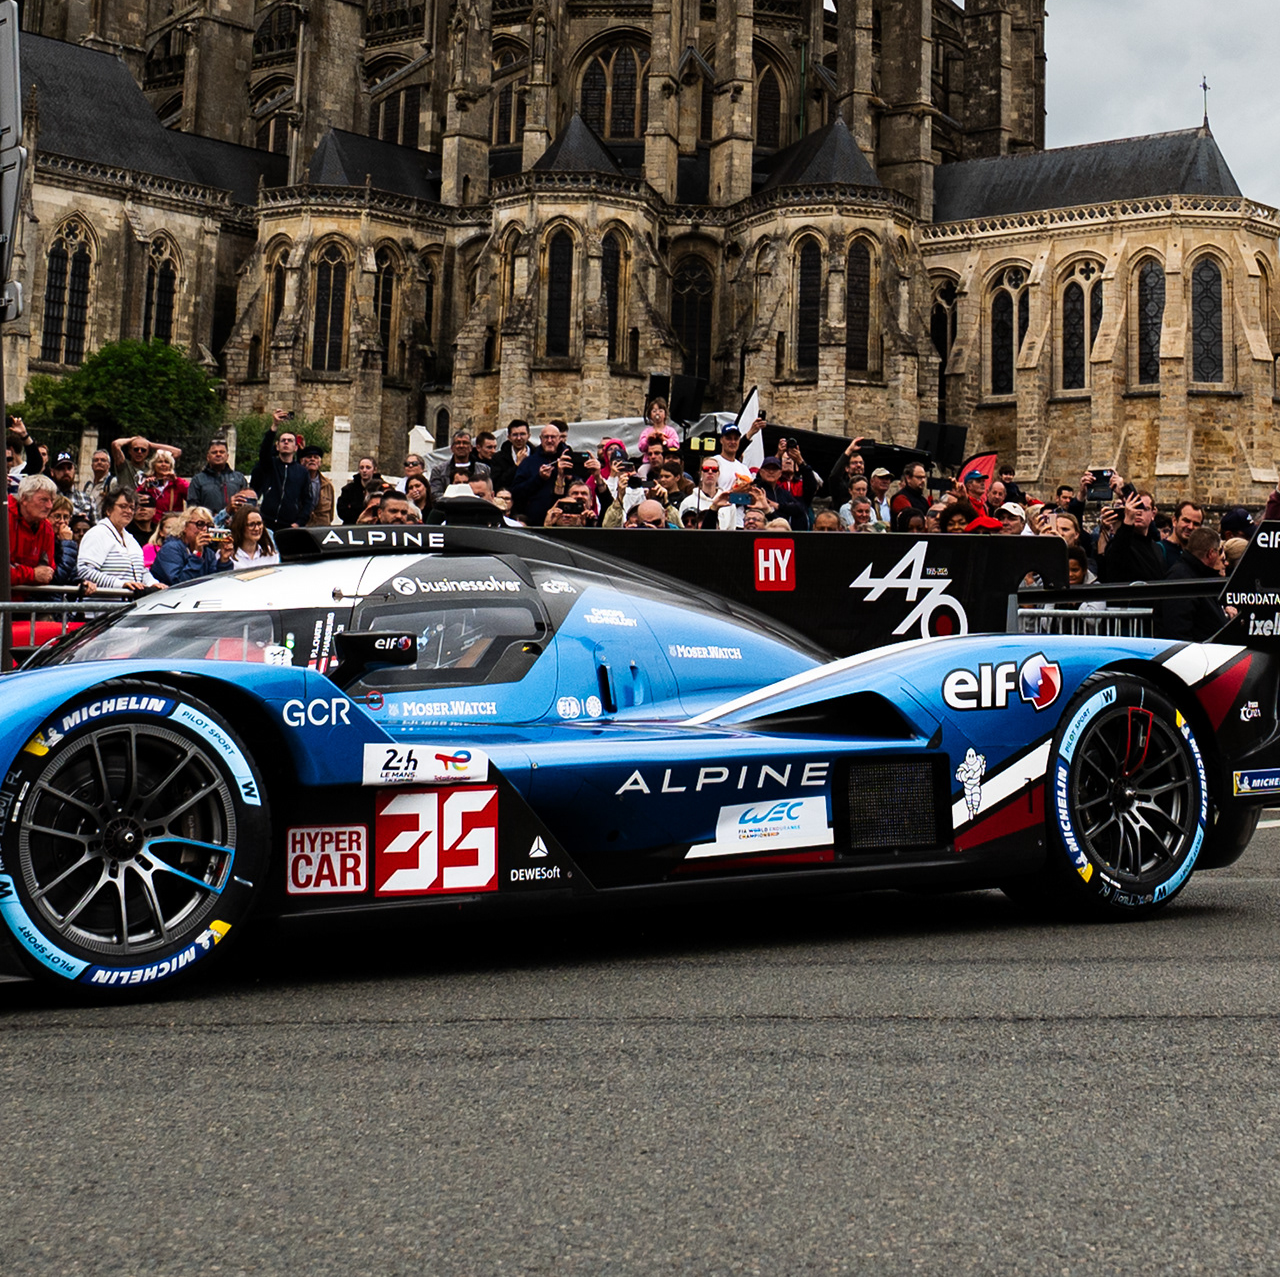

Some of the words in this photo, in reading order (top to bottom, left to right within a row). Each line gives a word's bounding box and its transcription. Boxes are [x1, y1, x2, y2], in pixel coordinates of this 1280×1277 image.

[321, 530, 445, 549] ALPINE
[757, 548, 792, 582] HY
[416, 575, 521, 593] businessolver
[374, 637, 398, 651] elf
[943, 662, 1017, 710] elf
[1102, 689, 1115, 704] W
[61, 696, 167, 732] MICHELIN
[282, 697, 351, 728] GCR
[181, 710, 209, 731] PILOT
[207, 727, 236, 756] SPORT
[1064, 729, 1078, 755] PILOT
[1074, 707, 1092, 730] SPORT
[381, 748, 419, 772] 24h
[241, 780, 258, 799] W
[615, 762, 831, 796] ALPINE
[1189, 738, 1208, 822] MICHELIN
[738, 801, 804, 826] WEC
[1056, 764, 1080, 854] MICHELIN
[291, 831, 362, 854] HYPER
[378, 788, 498, 892] 35
[290, 853, 362, 889] CAR
[510, 866, 561, 882] DEWESoft
[18, 925, 49, 956] SPORT
[47, 951, 76, 973] PILOT
[90, 945, 198, 985] MICHELIN
